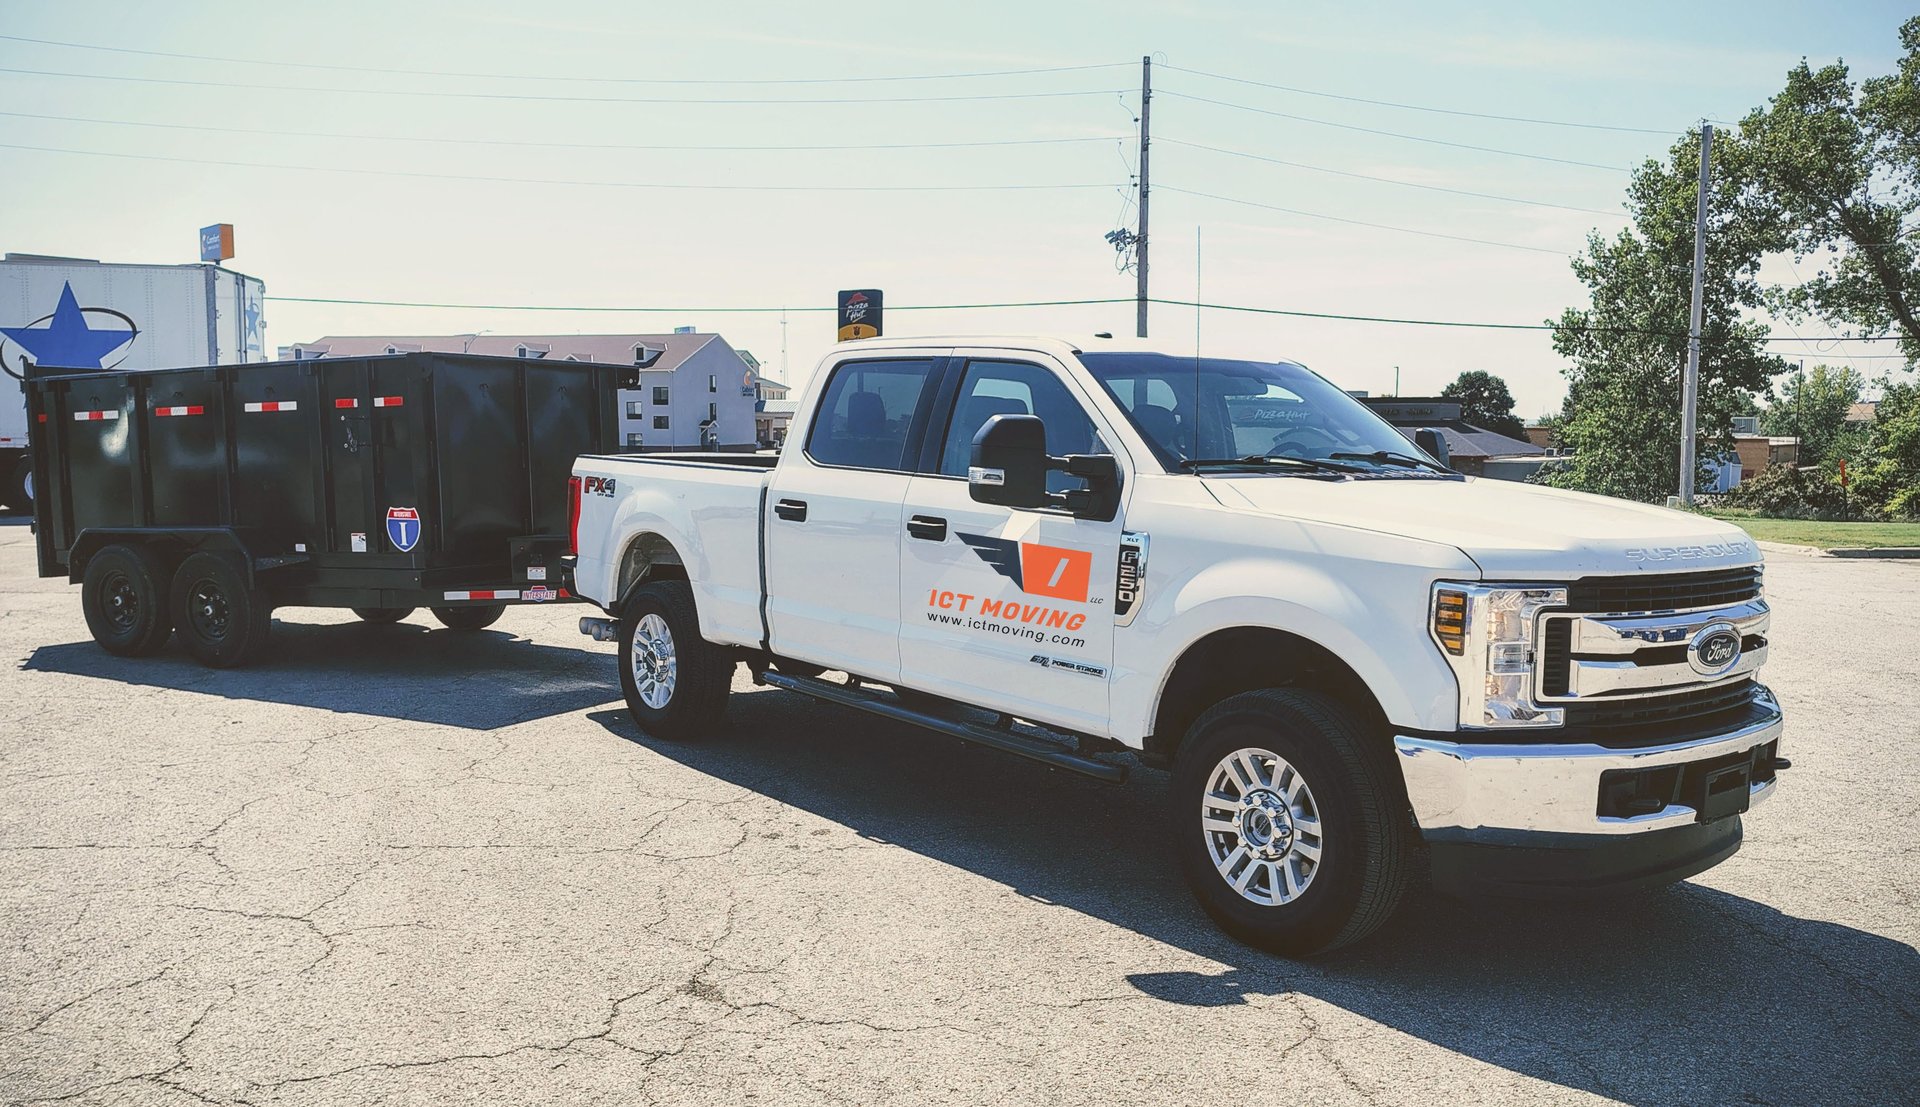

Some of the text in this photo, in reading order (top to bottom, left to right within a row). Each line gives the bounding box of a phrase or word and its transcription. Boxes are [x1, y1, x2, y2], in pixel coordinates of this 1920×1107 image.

[584, 476, 617, 494] FX4
[522, 591, 556, 600] INTERSTATE
[928, 588, 1087, 631] ICT MOVING
[927, 612, 1085, 648] www.ictmoving.com
[1707, 638, 1733, 661] Ford
[1051, 659, 1076, 670] POWER
[1075, 664, 1104, 675] STROKE
